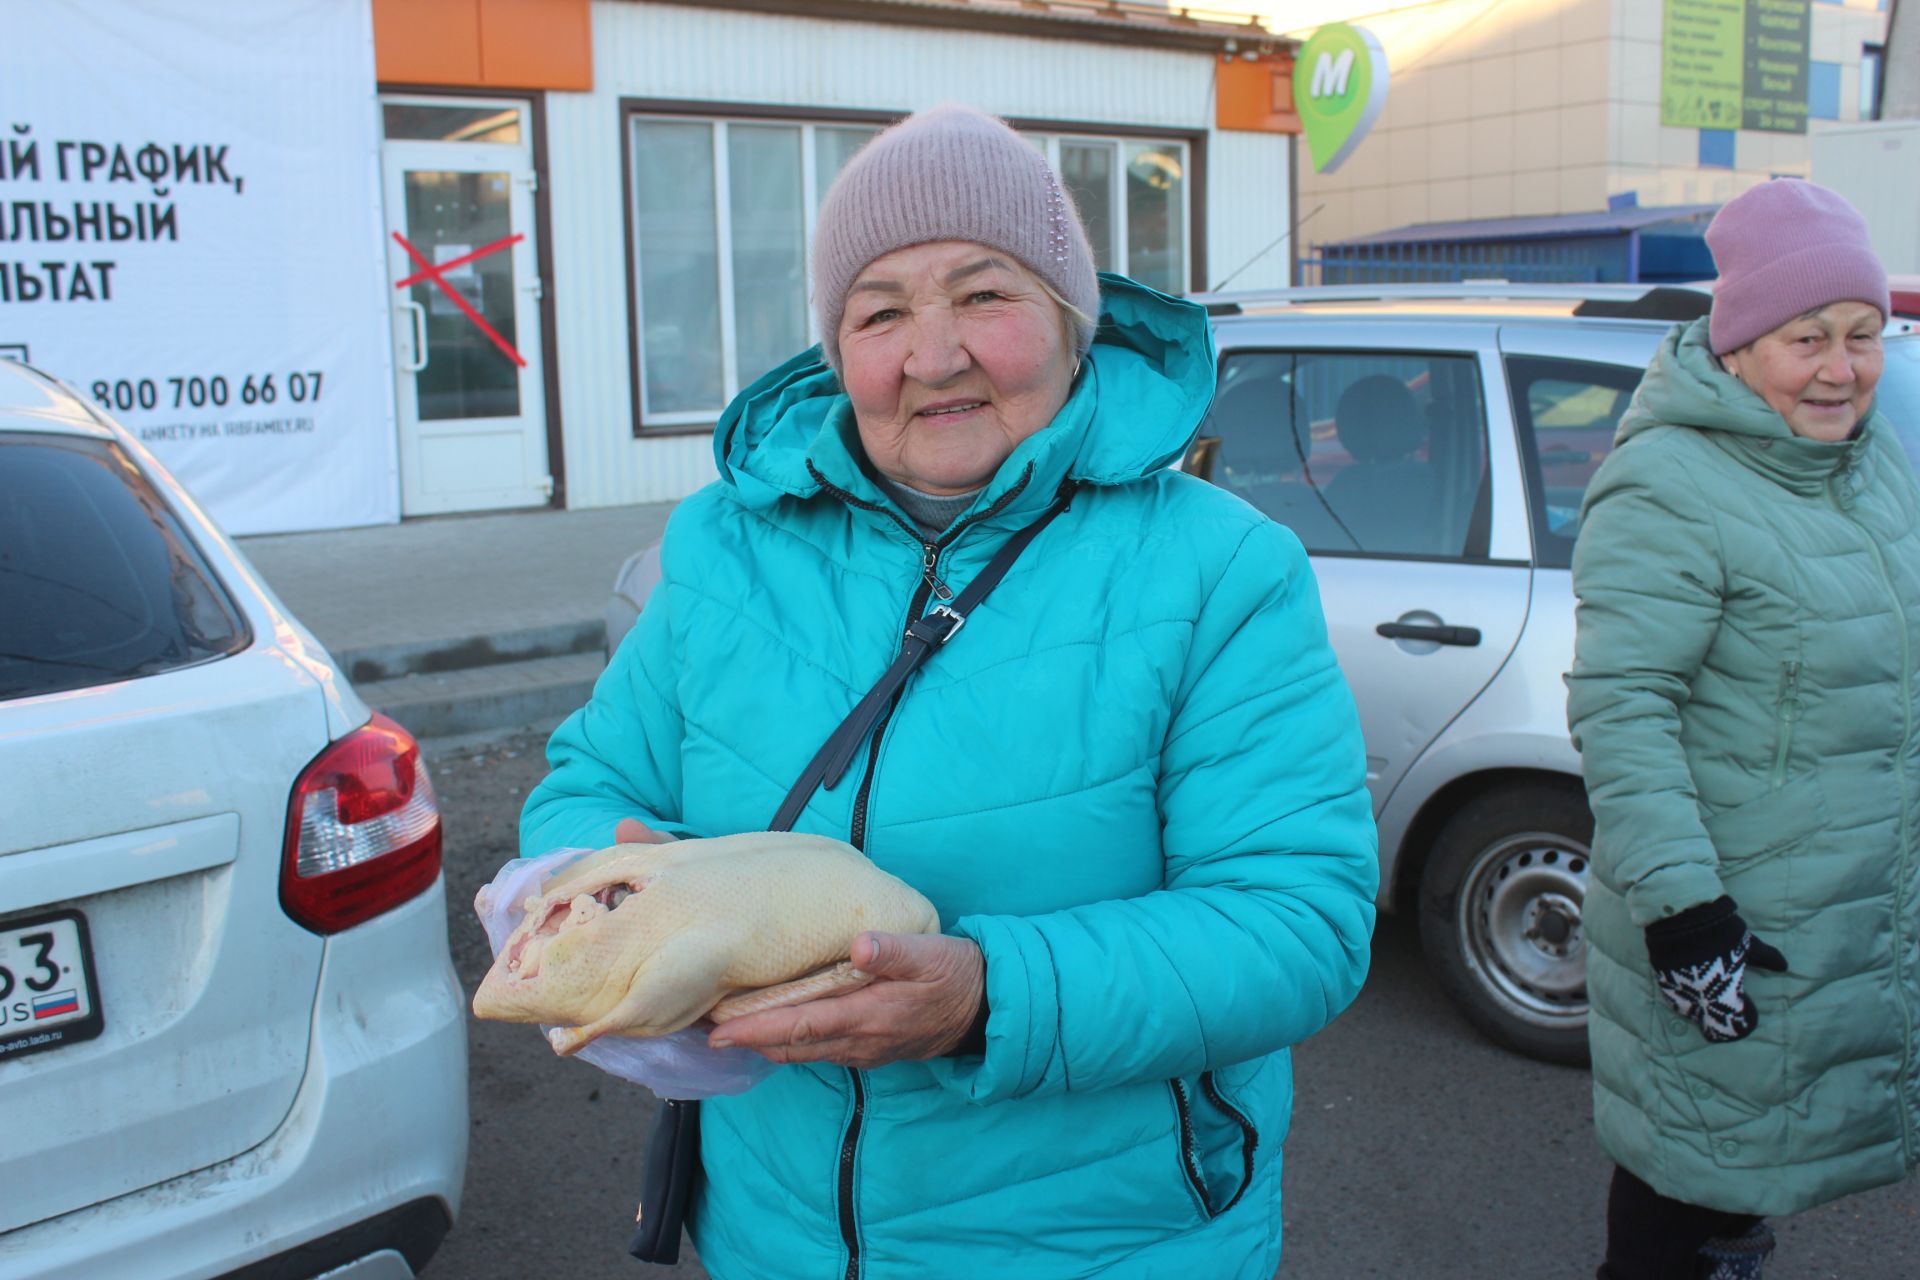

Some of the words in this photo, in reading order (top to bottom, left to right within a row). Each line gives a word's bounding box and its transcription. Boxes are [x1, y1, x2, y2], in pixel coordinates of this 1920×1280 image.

[57, 142, 243, 194] ГРАФИК,
[92, 379, 157, 411] 800
[168, 376, 228, 409] 700
[242, 372, 277, 405] 66
[289, 370, 322, 403] 07
